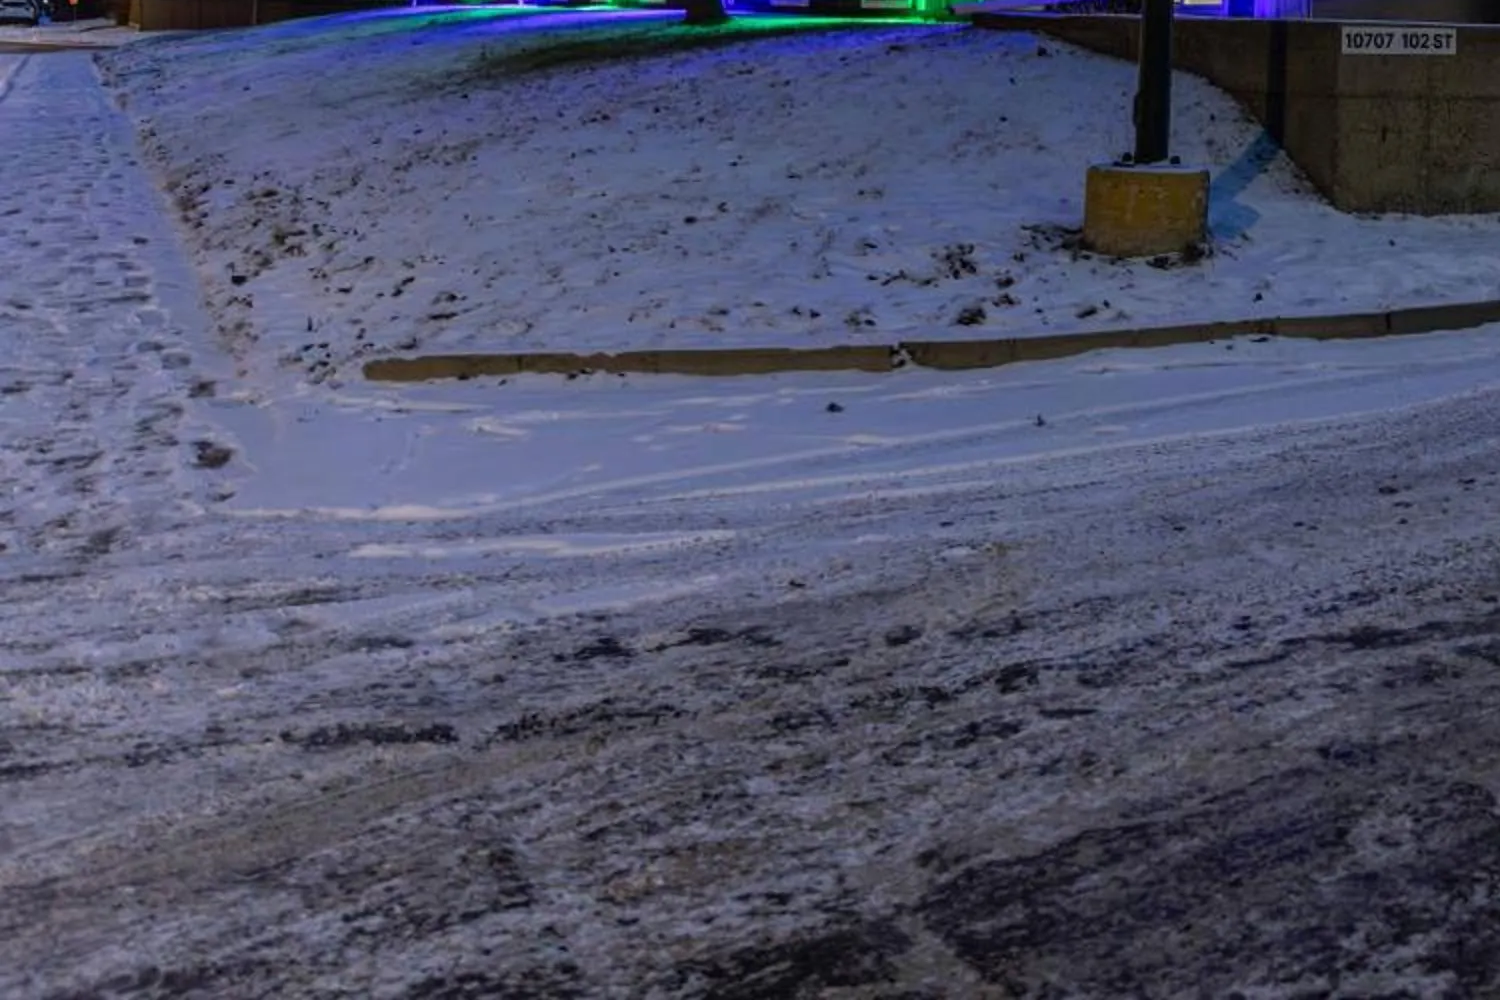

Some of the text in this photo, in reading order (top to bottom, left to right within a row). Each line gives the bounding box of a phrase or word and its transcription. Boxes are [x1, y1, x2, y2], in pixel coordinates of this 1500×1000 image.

[1345, 33, 1453, 49] 10707 102 ST
